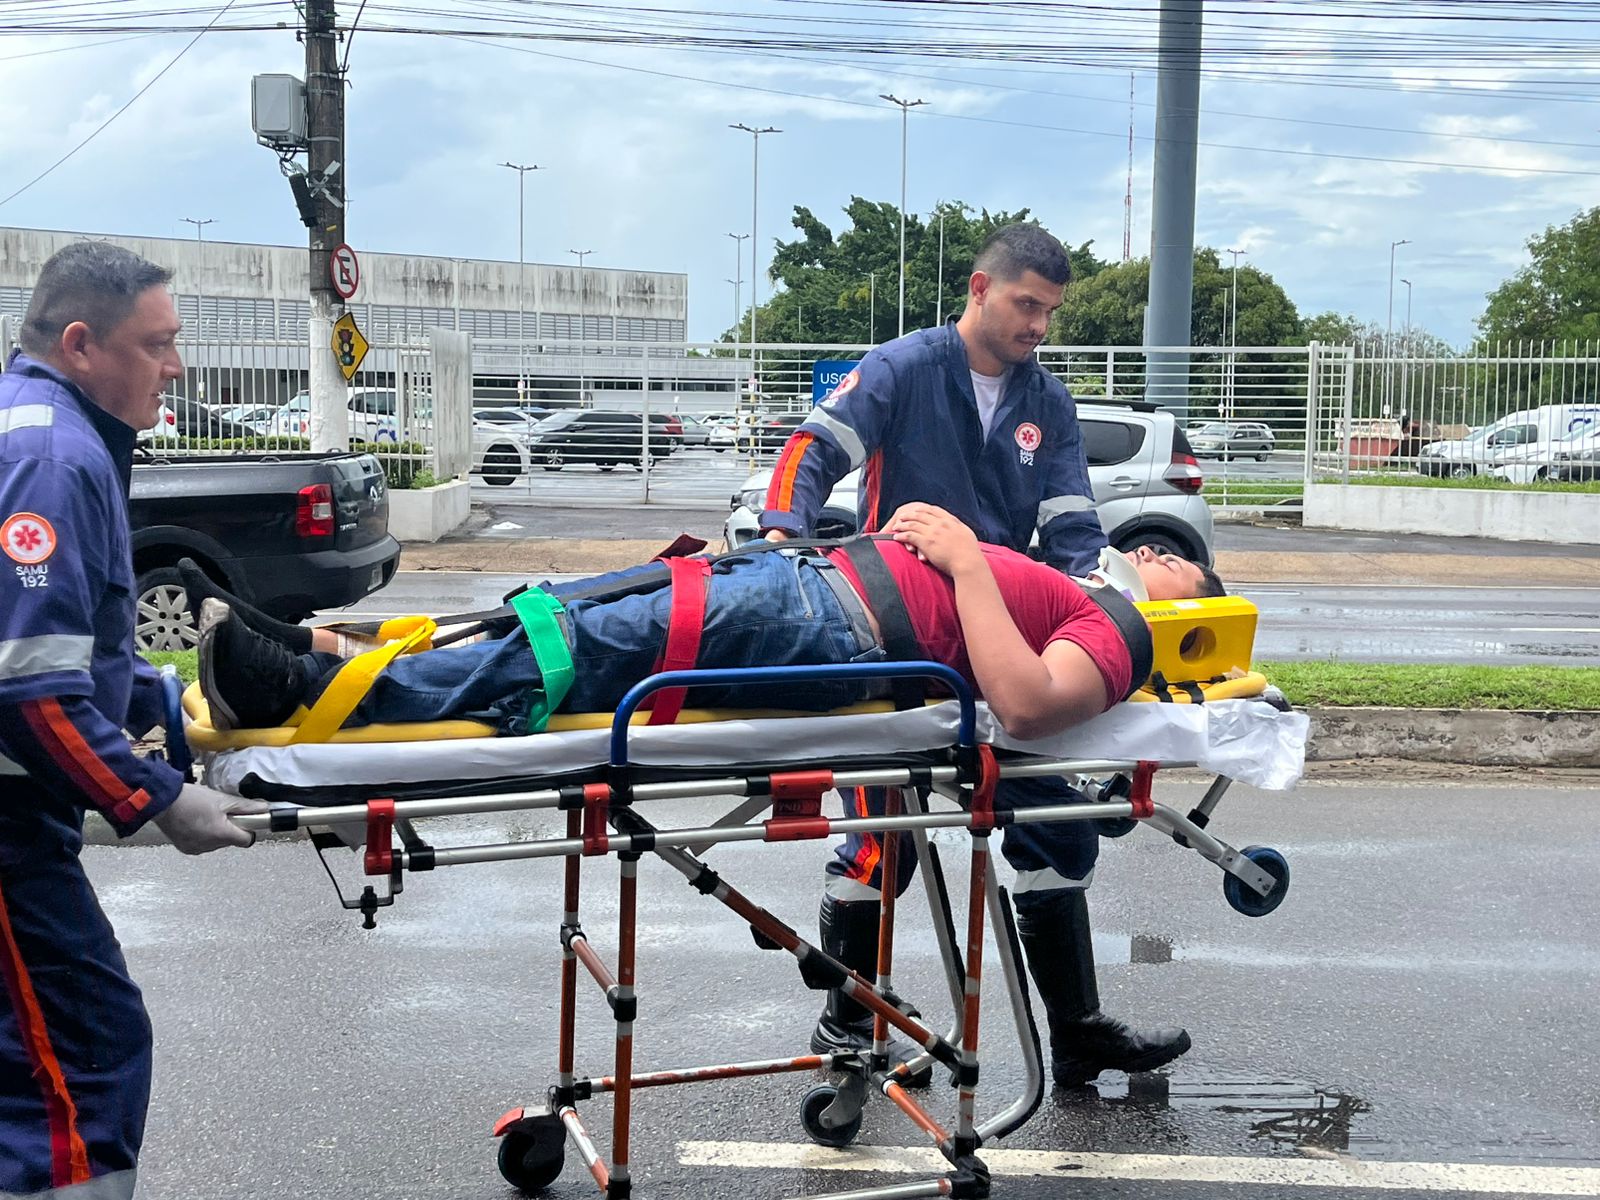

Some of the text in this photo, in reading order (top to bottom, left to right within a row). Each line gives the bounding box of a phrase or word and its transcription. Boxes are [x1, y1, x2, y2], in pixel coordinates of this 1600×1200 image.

[1019, 455, 1034, 467] 192
[15, 564, 49, 576] SAMU
[20, 575, 49, 588] 192
